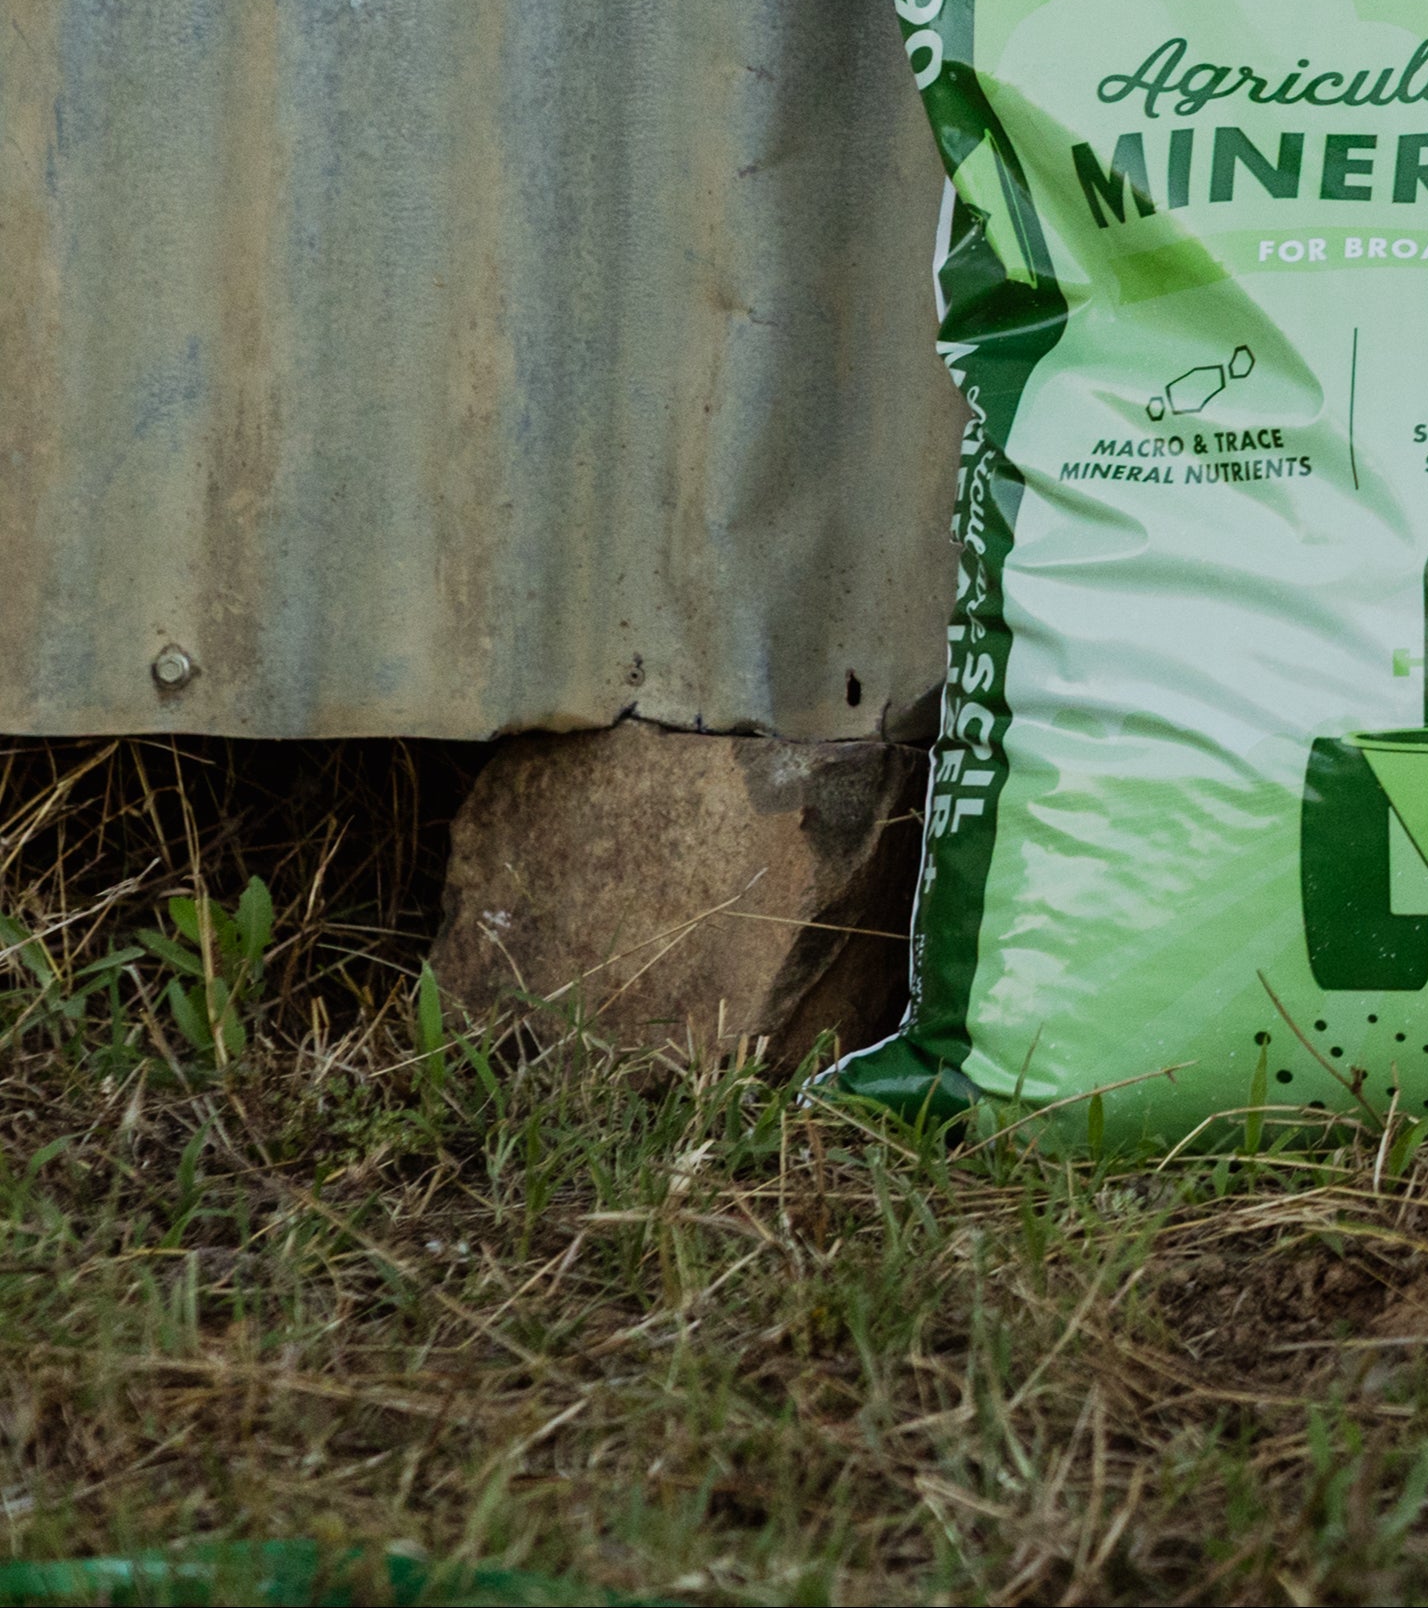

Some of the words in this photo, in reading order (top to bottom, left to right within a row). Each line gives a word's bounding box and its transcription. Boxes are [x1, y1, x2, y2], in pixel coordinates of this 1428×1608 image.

[1258, 239, 1328, 264] FOR
[1091, 434, 1186, 458] MACRO
[1192, 430, 1208, 454] &
[1212, 427, 1285, 453] TRACE
[1058, 460, 1176, 485] MINERAL
[1184, 455, 1313, 485] NUTRIENTS
